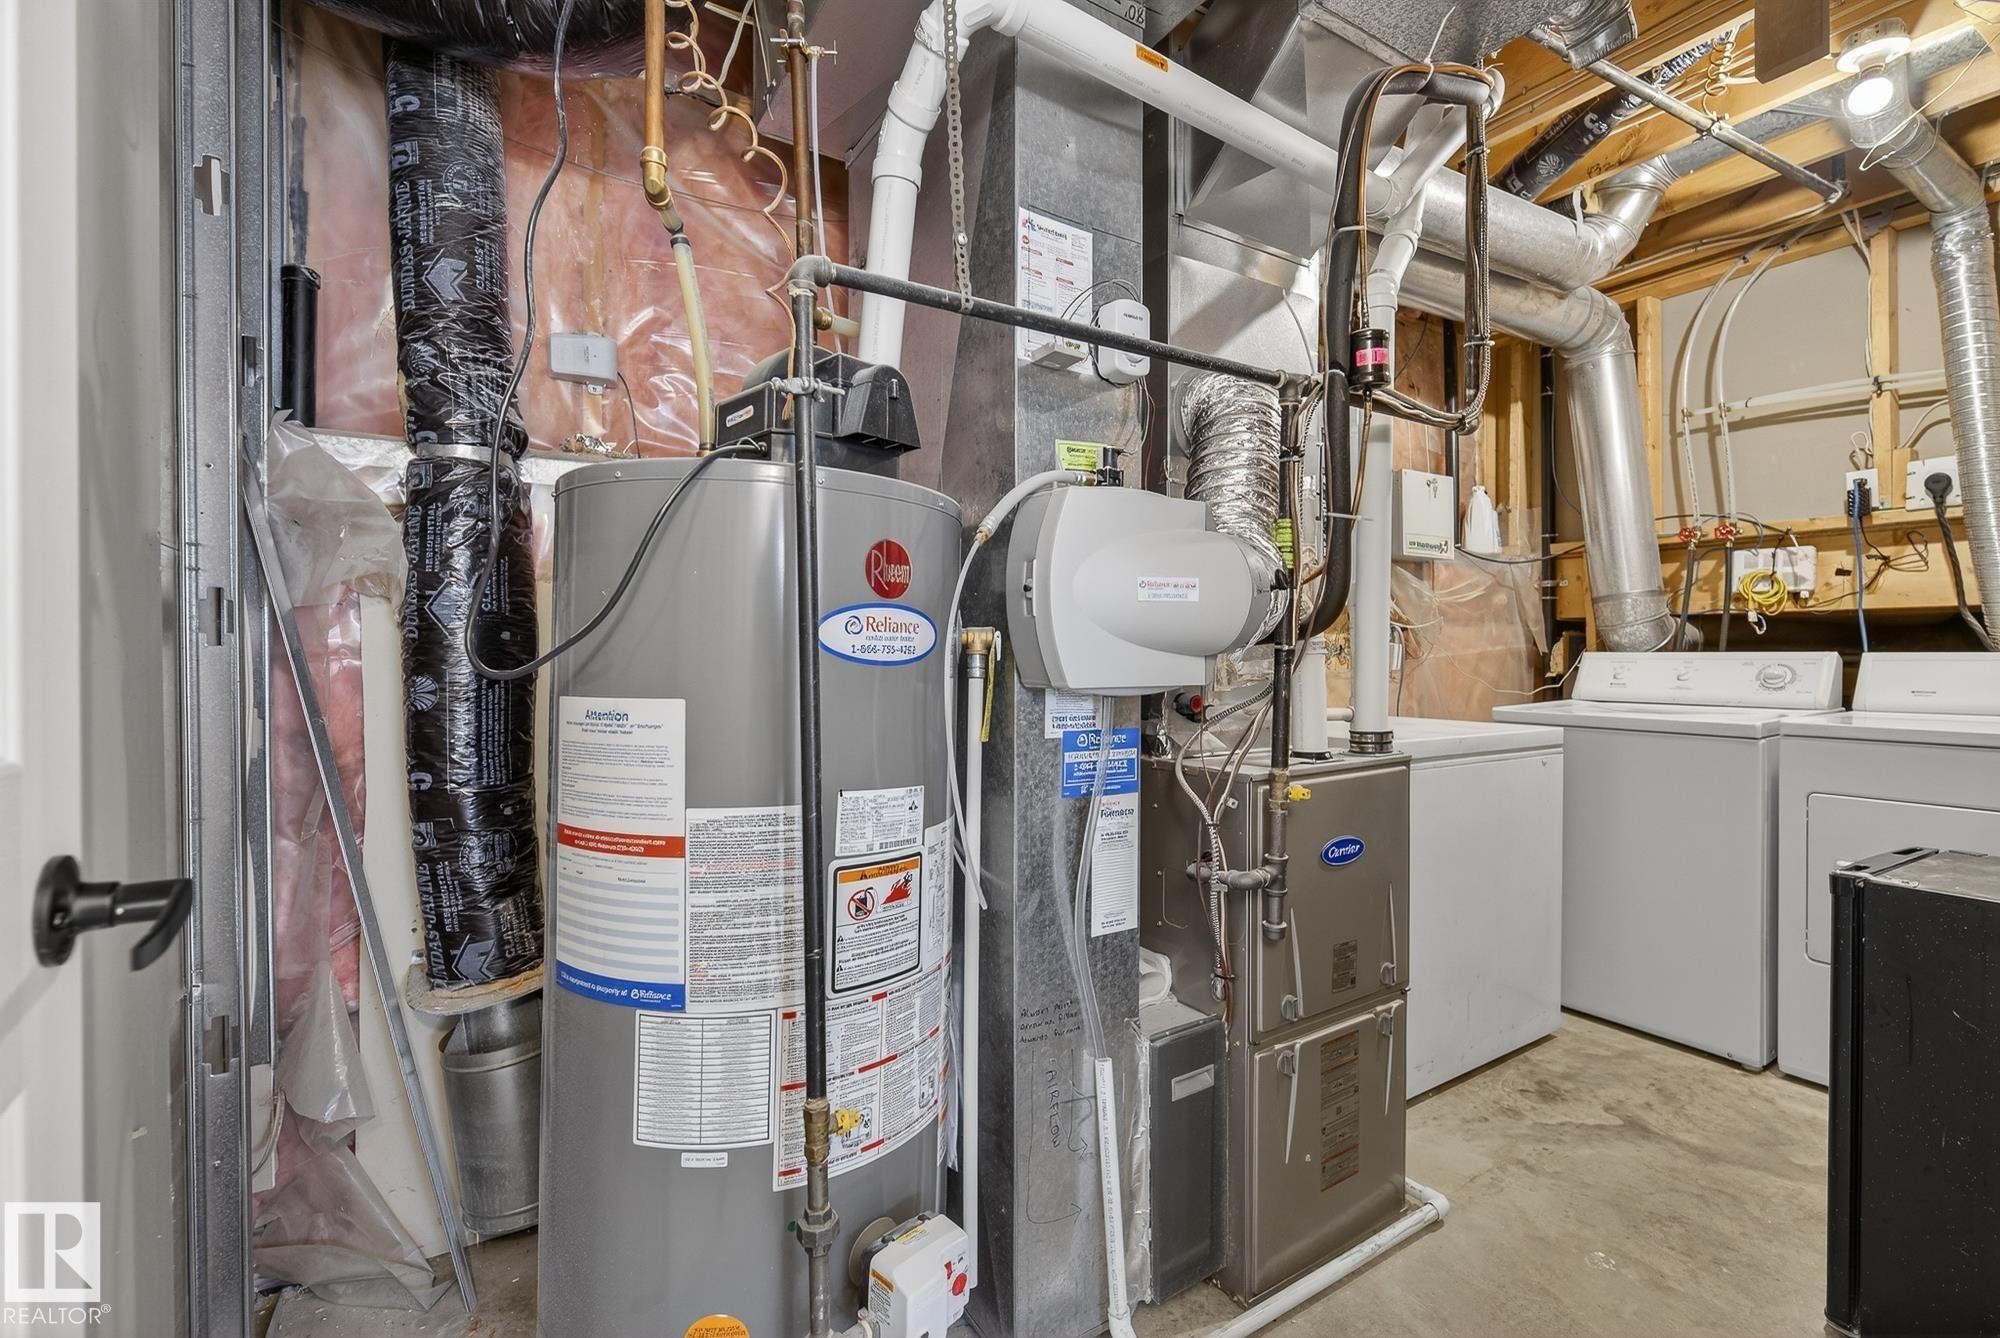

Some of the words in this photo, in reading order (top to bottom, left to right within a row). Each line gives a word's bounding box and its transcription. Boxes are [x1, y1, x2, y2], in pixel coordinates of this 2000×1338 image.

[871, 541, 910, 590] Rheem
[866, 616, 919, 634] Reliance
[585, 709, 629, 722] Attention
[1328, 843, 1361, 860] Carrier
[1045, 1069, 1061, 1148] AIRFLOW
